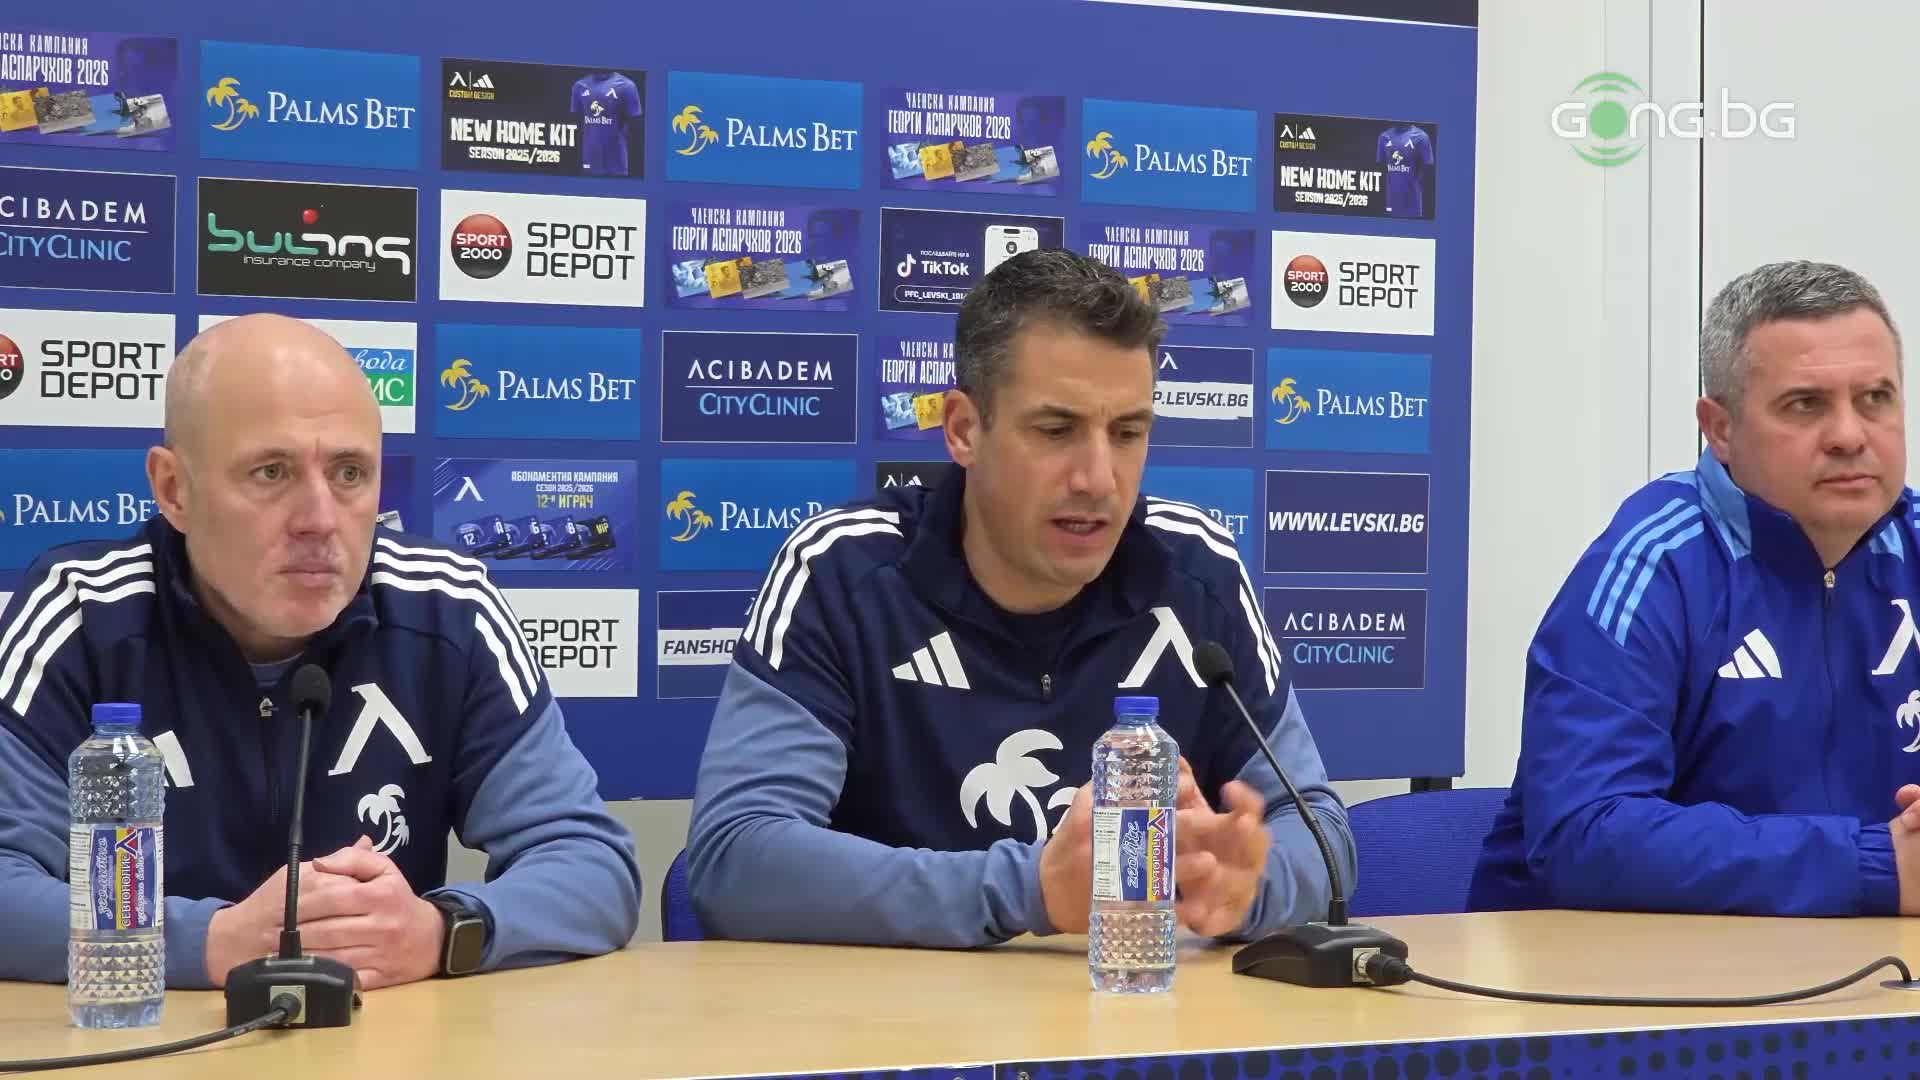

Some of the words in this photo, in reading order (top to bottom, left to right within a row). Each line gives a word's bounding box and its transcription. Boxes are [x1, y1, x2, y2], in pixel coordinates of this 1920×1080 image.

[30, 34, 88, 56] КАМПАНИЯ
[2, 54, 72, 83] АСПАРУХОВ
[78, 59, 108, 86] 2026
[267, 91, 358, 126] PALMS
[364, 98, 416, 130] BET
[906, 92, 944, 110] ЧЛЕНСКА
[948, 94, 994, 113] КАМПАНИЯ
[450, 118, 492, 142] NEW
[496, 120, 546, 146] HOME
[550, 124, 578, 147] KIT
[726, 118, 807, 149] PALMS
[813, 122, 858, 152] BET
[888, 110, 922, 134] ГЕОРГИ
[926, 112, 982, 138] АСПАРУХОВ
[986, 116, 1010, 140] 2026
[469, 146, 504, 160] SEASON
[506, 148, 560, 164] 2025/2026
[1134, 144, 1207, 174] PALMS
[1211, 149, 1252, 178] BET
[1280, 166, 1314, 188] NEW
[1317, 168, 1356, 191] HOME
[1360, 170, 1382, 192] KIT
[0, 196, 146, 224] CIBADEM
[1295, 191, 1324, 204] SEASON
[1324, 194, 1368, 208] 2025/2026
[692, 208, 730, 224] ЧЛЕНСКА
[736, 209, 784, 228] КАМПАНИЯ
[456, 233, 508, 247] SPORT
[528, 222, 637, 252] SPORT
[672, 226, 708, 251] ГЕОРГИ
[712, 228, 771, 252] АСПАРУХОВ
[776, 230, 802, 254] 2026
[1105, 226, 1140, 244] ЧЛЕНСКА
[1145, 228, 1188, 246] КАМПАНИЯ
[244, 255, 310, 266] insurance
[314, 258, 376, 272] company
[460, 248, 502, 260] 2000
[527, 251, 635, 280] DEPOT
[1124, 246, 1176, 270] АСПАРУХОВ
[1180, 249, 1204, 272] 2026
[921, 260, 969, 276] TikTok
[1288, 271, 1325, 281] SPORT
[1340, 262, 1420, 285] SPORT
[1290, 282, 1322, 292] 2000
[1339, 285, 1418, 308] DEPOT
[41, 340, 166, 370] SPORT
[900, 340, 938, 358] ЧЛЕНСКА
[688, 358, 832, 381] ACIBADEM
[882, 360, 916, 384] ГЕОРГИ
[40, 370, 164, 400] DEPOT
[498, 370, 582, 401] PALMS
[588, 372, 636, 402] BET
[1152, 391, 1248, 407] P.LEVSKI.BG
[1316, 388, 1384, 416] PALMS
[1389, 391, 1428, 418] BET
[512, 471, 572, 482] АБОНАМЕНТНА
[574, 472, 618, 483] КАМПАНИЯ
[536, 484, 556, 492] СЕЗОН
[558, 484, 594, 493] 2025/2026
[12, 494, 110, 526] PALMS
[116, 493, 157, 525] BE
[558, 494, 594, 508] ИГРАЧ
[1268, 512, 1424, 534] WWW.LEVSKI.BG
[520, 619, 620, 642] SPORT
[1284, 612, 1406, 632] ACIBADEM
[1121, 820, 1140, 889] zeolite
